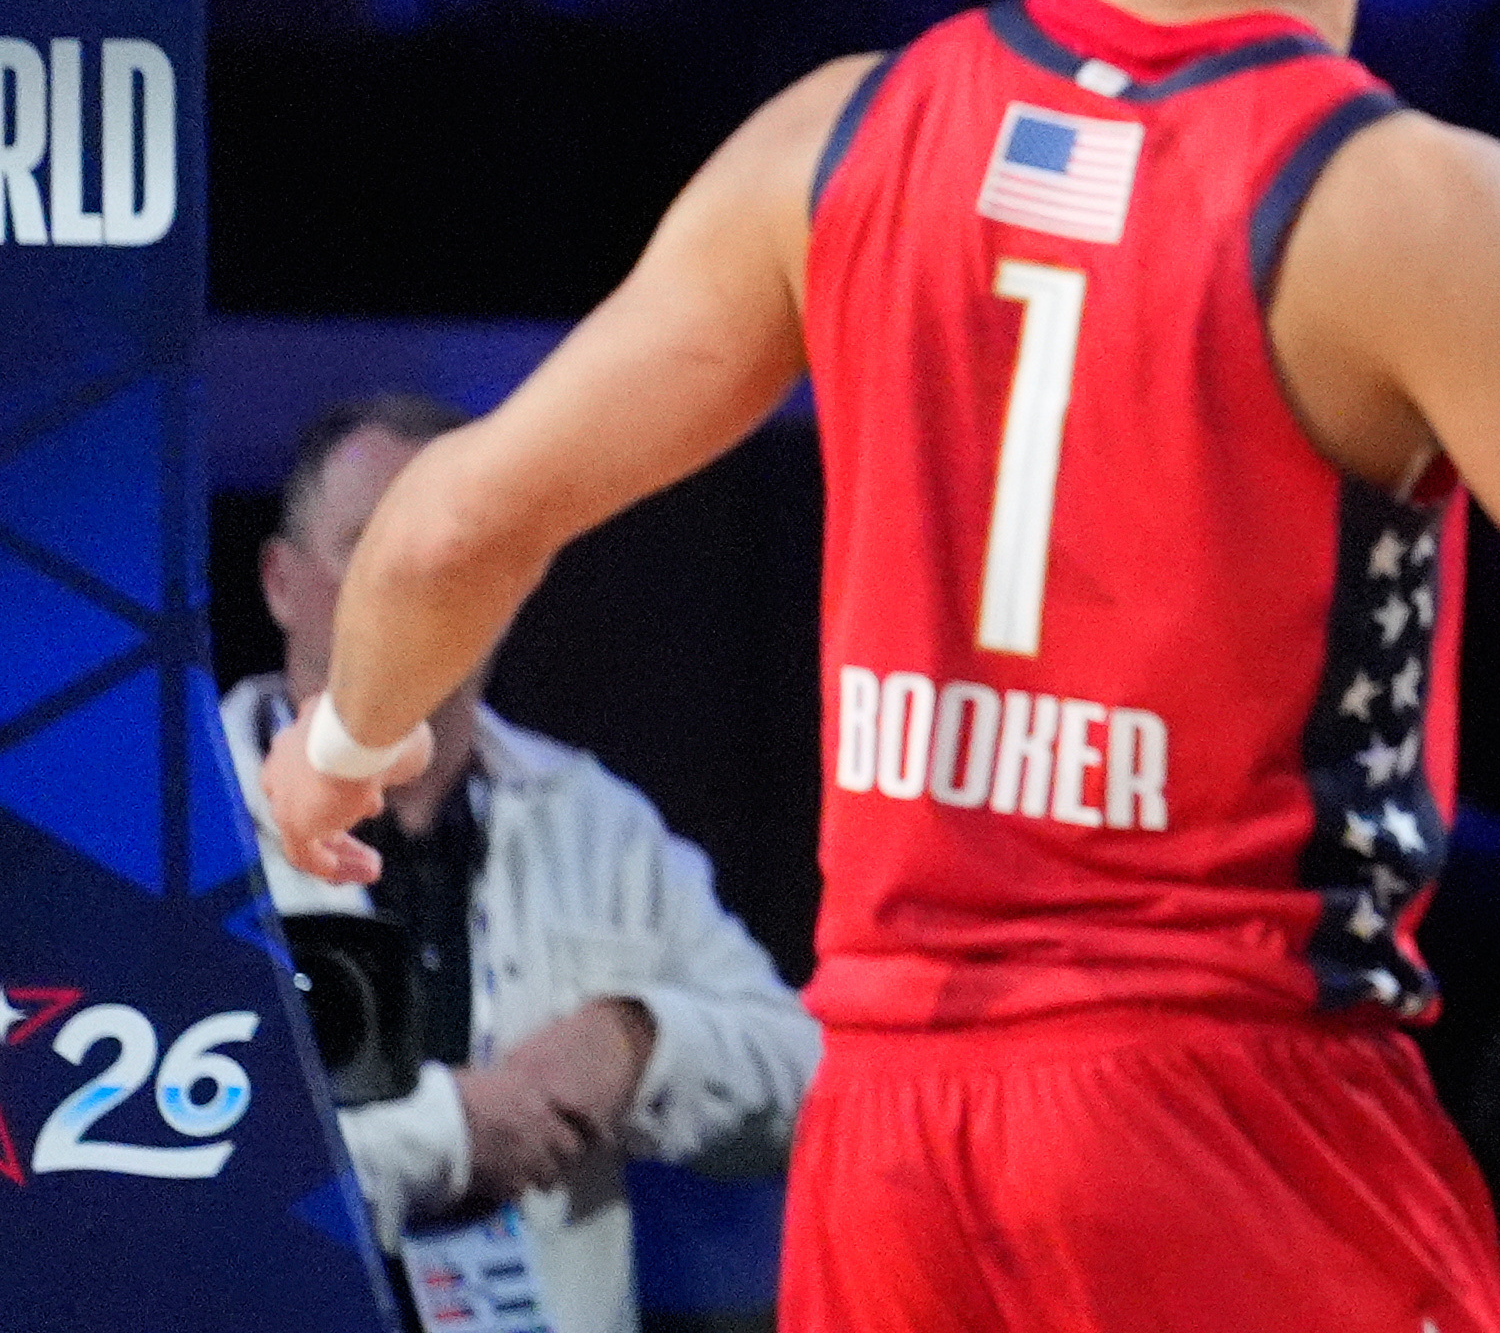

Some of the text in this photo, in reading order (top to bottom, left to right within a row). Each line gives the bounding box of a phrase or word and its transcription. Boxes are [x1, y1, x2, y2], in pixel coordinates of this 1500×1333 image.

[978, 259, 1087, 656] 1
[837, 665, 1169, 831] BOOKER
[32, 1002, 261, 1180] 26
